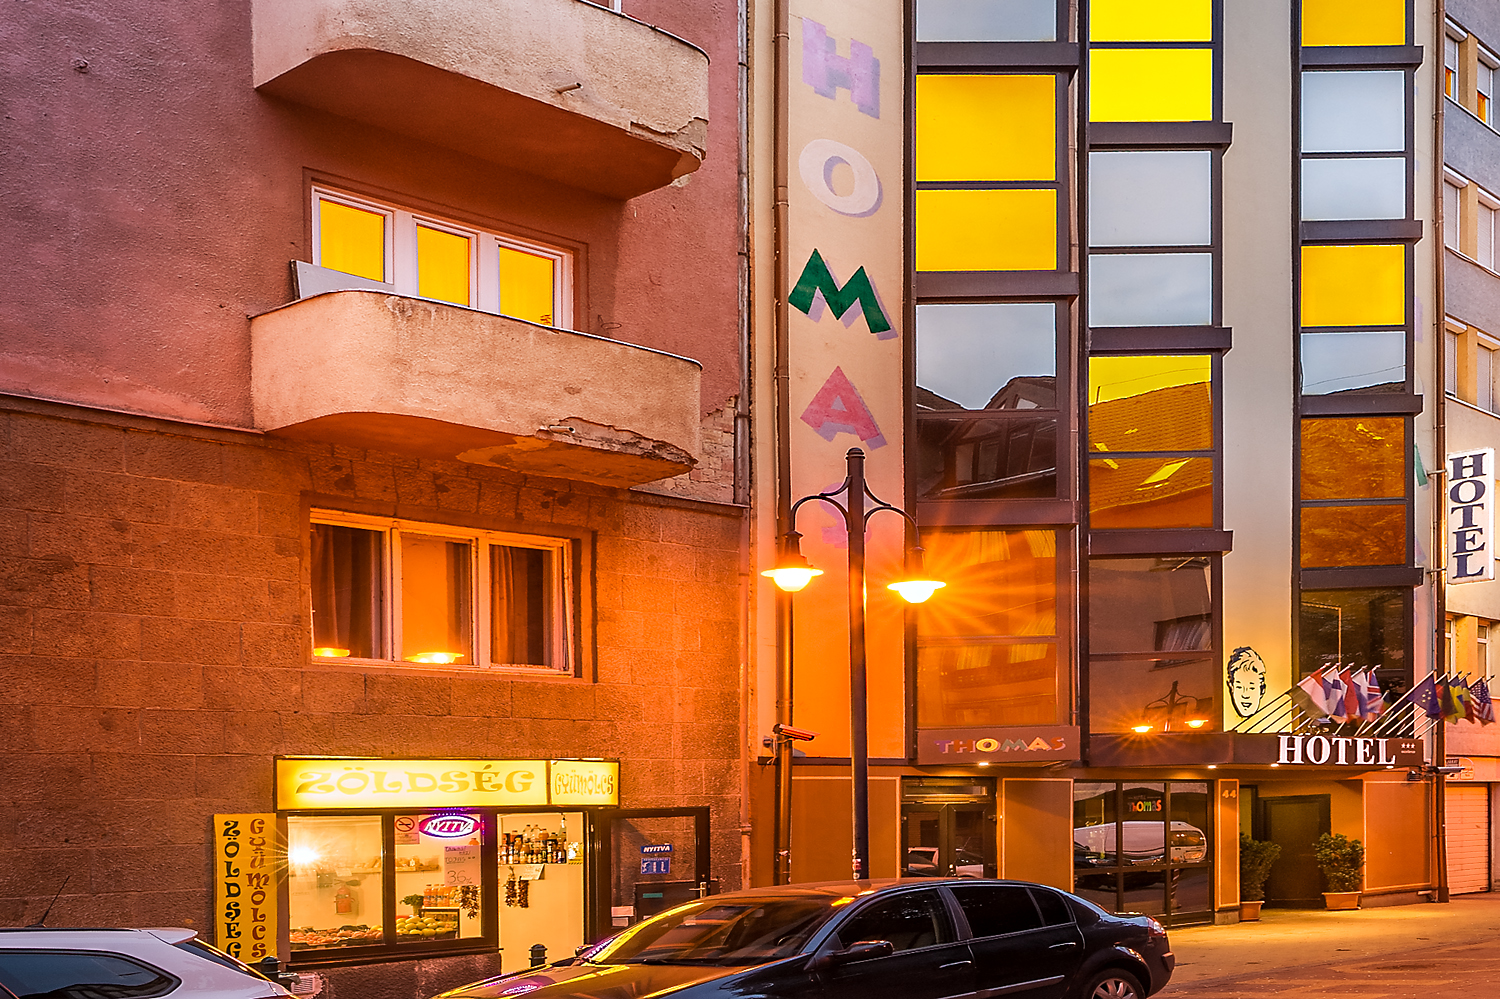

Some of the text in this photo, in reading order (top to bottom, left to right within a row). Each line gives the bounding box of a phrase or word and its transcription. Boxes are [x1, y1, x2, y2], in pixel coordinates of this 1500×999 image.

[1449, 452, 1487, 579] HOTEL
[934, 736, 1066, 754] THOMAS
[1276, 735, 1396, 765] HOTEL
[295, 764, 535, 795] ZÖLDSÉG
[554, 769, 614, 797] GYÜMÖLCS
[1222, 789, 1238, 799] 44
[424, 820, 475, 832] NYITVA
[643, 845, 671, 853] NYITVA
